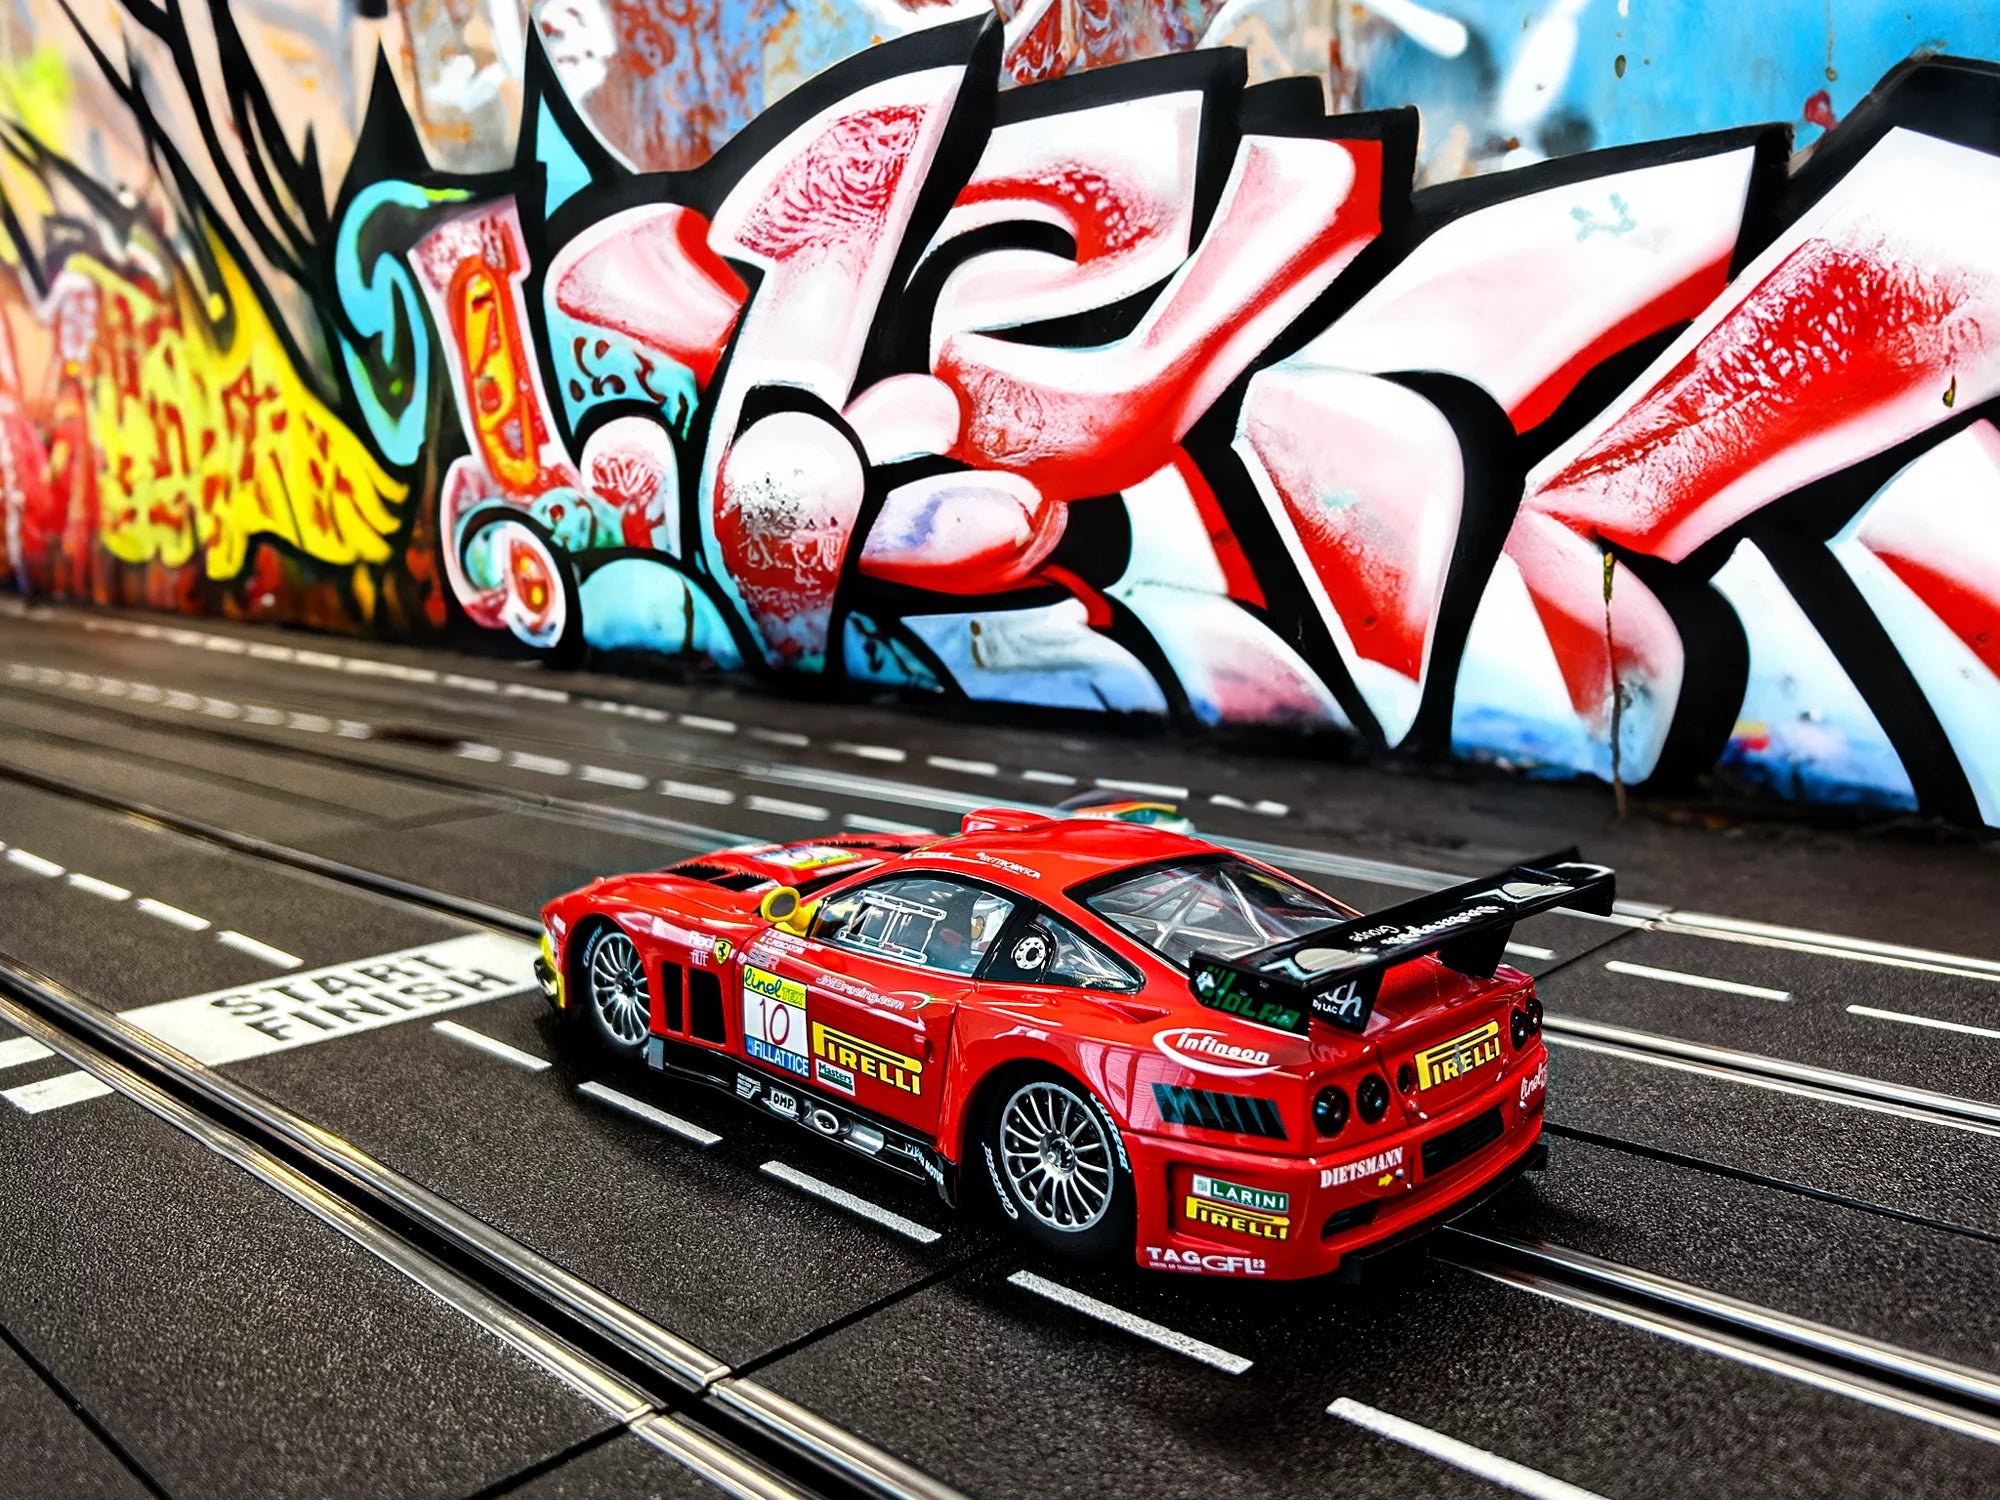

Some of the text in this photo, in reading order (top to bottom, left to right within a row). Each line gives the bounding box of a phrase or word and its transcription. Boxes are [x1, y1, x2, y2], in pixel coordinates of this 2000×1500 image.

[210, 955, 452, 1016] START
[245, 969, 517, 1042] FINISH
[782, 986, 805, 1006] TEX
[759, 998, 791, 1046] 10
[753, 1040, 810, 1078] FILLATTICE
[811, 1019, 923, 1096] PIRELLI
[1175, 1031, 1270, 1065] Infineon
[1414, 1020, 1501, 1091] PIRELLI
[818, 1061, 853, 1084] Masters
[773, 1093, 795, 1110] OMP
[1320, 1146, 1404, 1189] DIETSMANN
[1212, 1182, 1286, 1210] LARINI
[1185, 1195, 1291, 1240] PIRELLI
[1146, 1246, 1201, 1265] TAG
